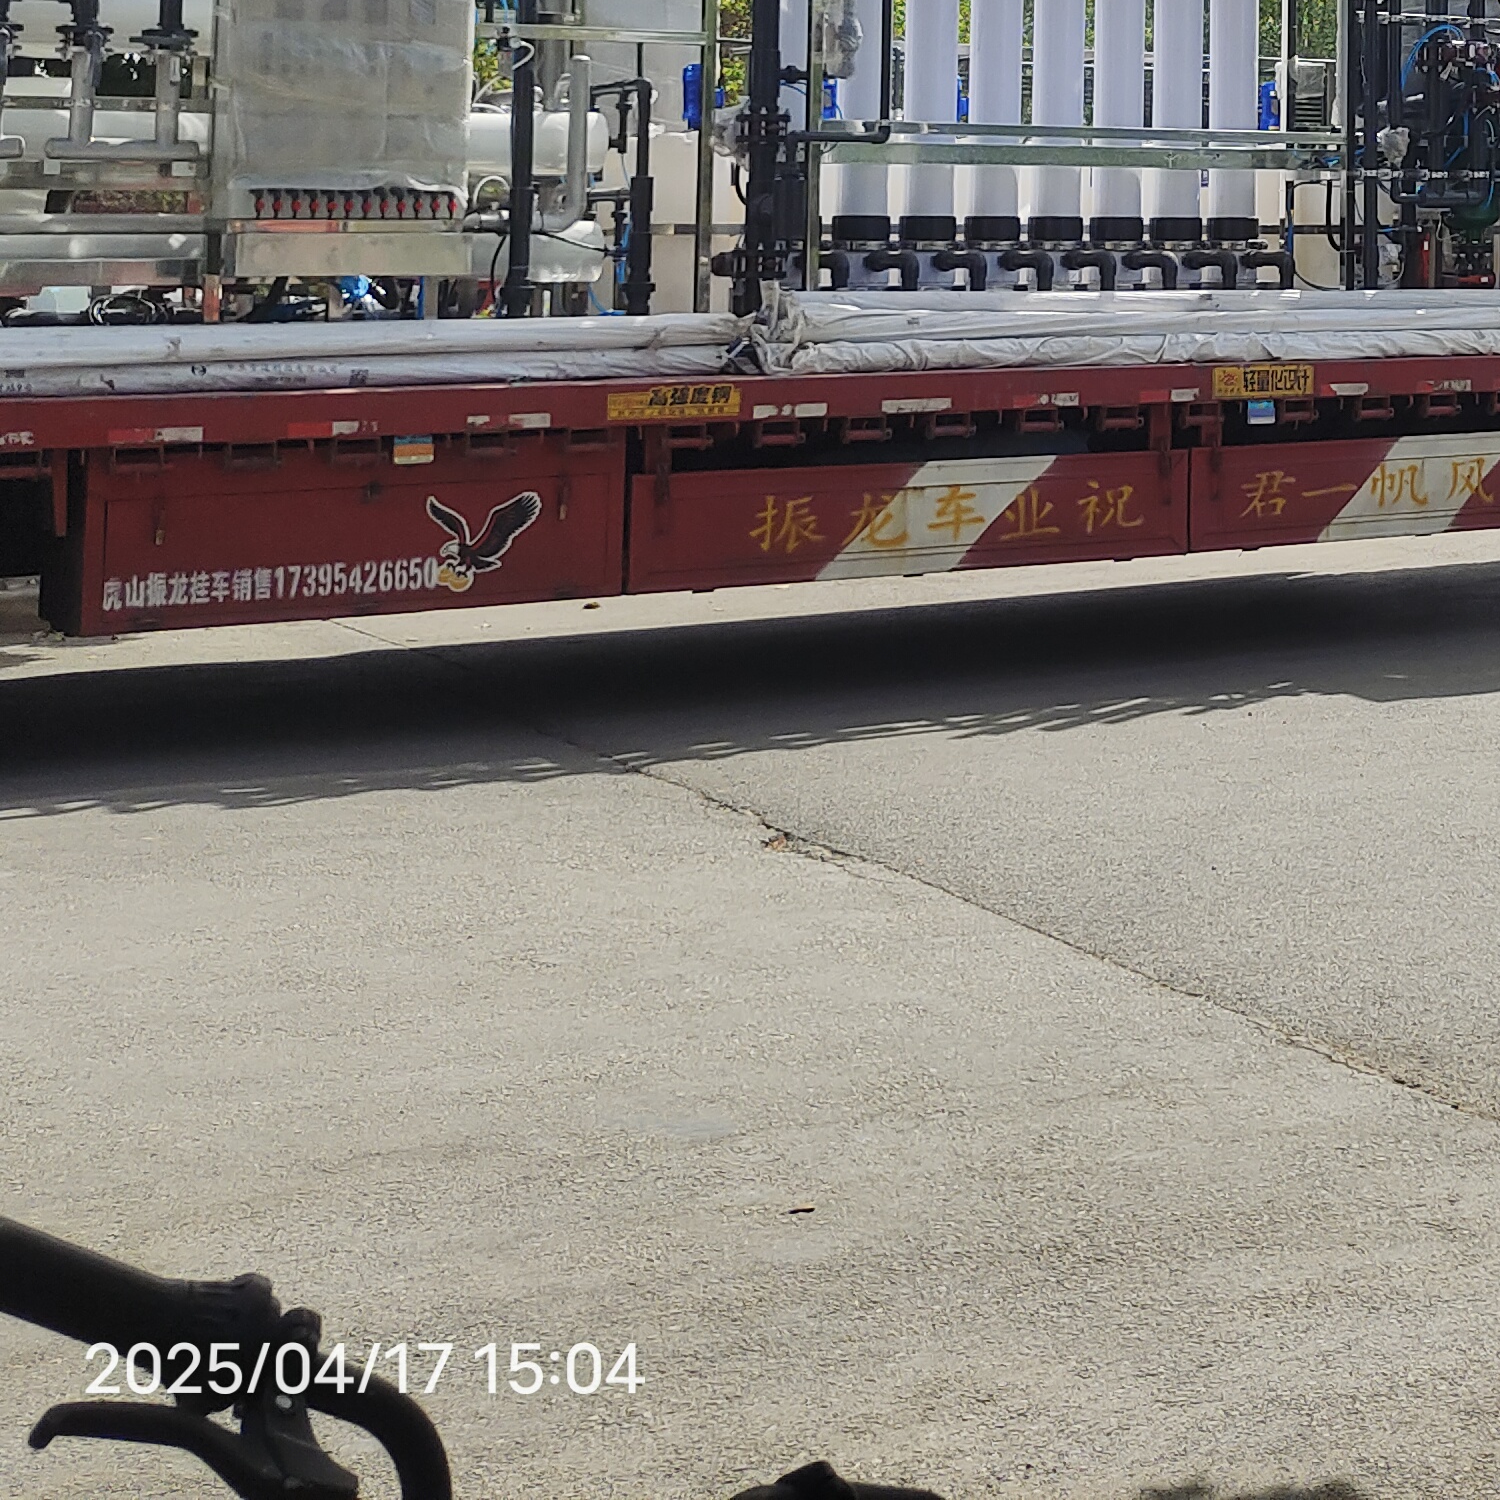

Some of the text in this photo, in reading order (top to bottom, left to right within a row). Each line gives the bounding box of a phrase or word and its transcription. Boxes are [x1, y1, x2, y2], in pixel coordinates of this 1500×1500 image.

[1243, 367, 1310, 394] 轻量化设计
[749, 481, 1144, 553] 振龙车业祝
